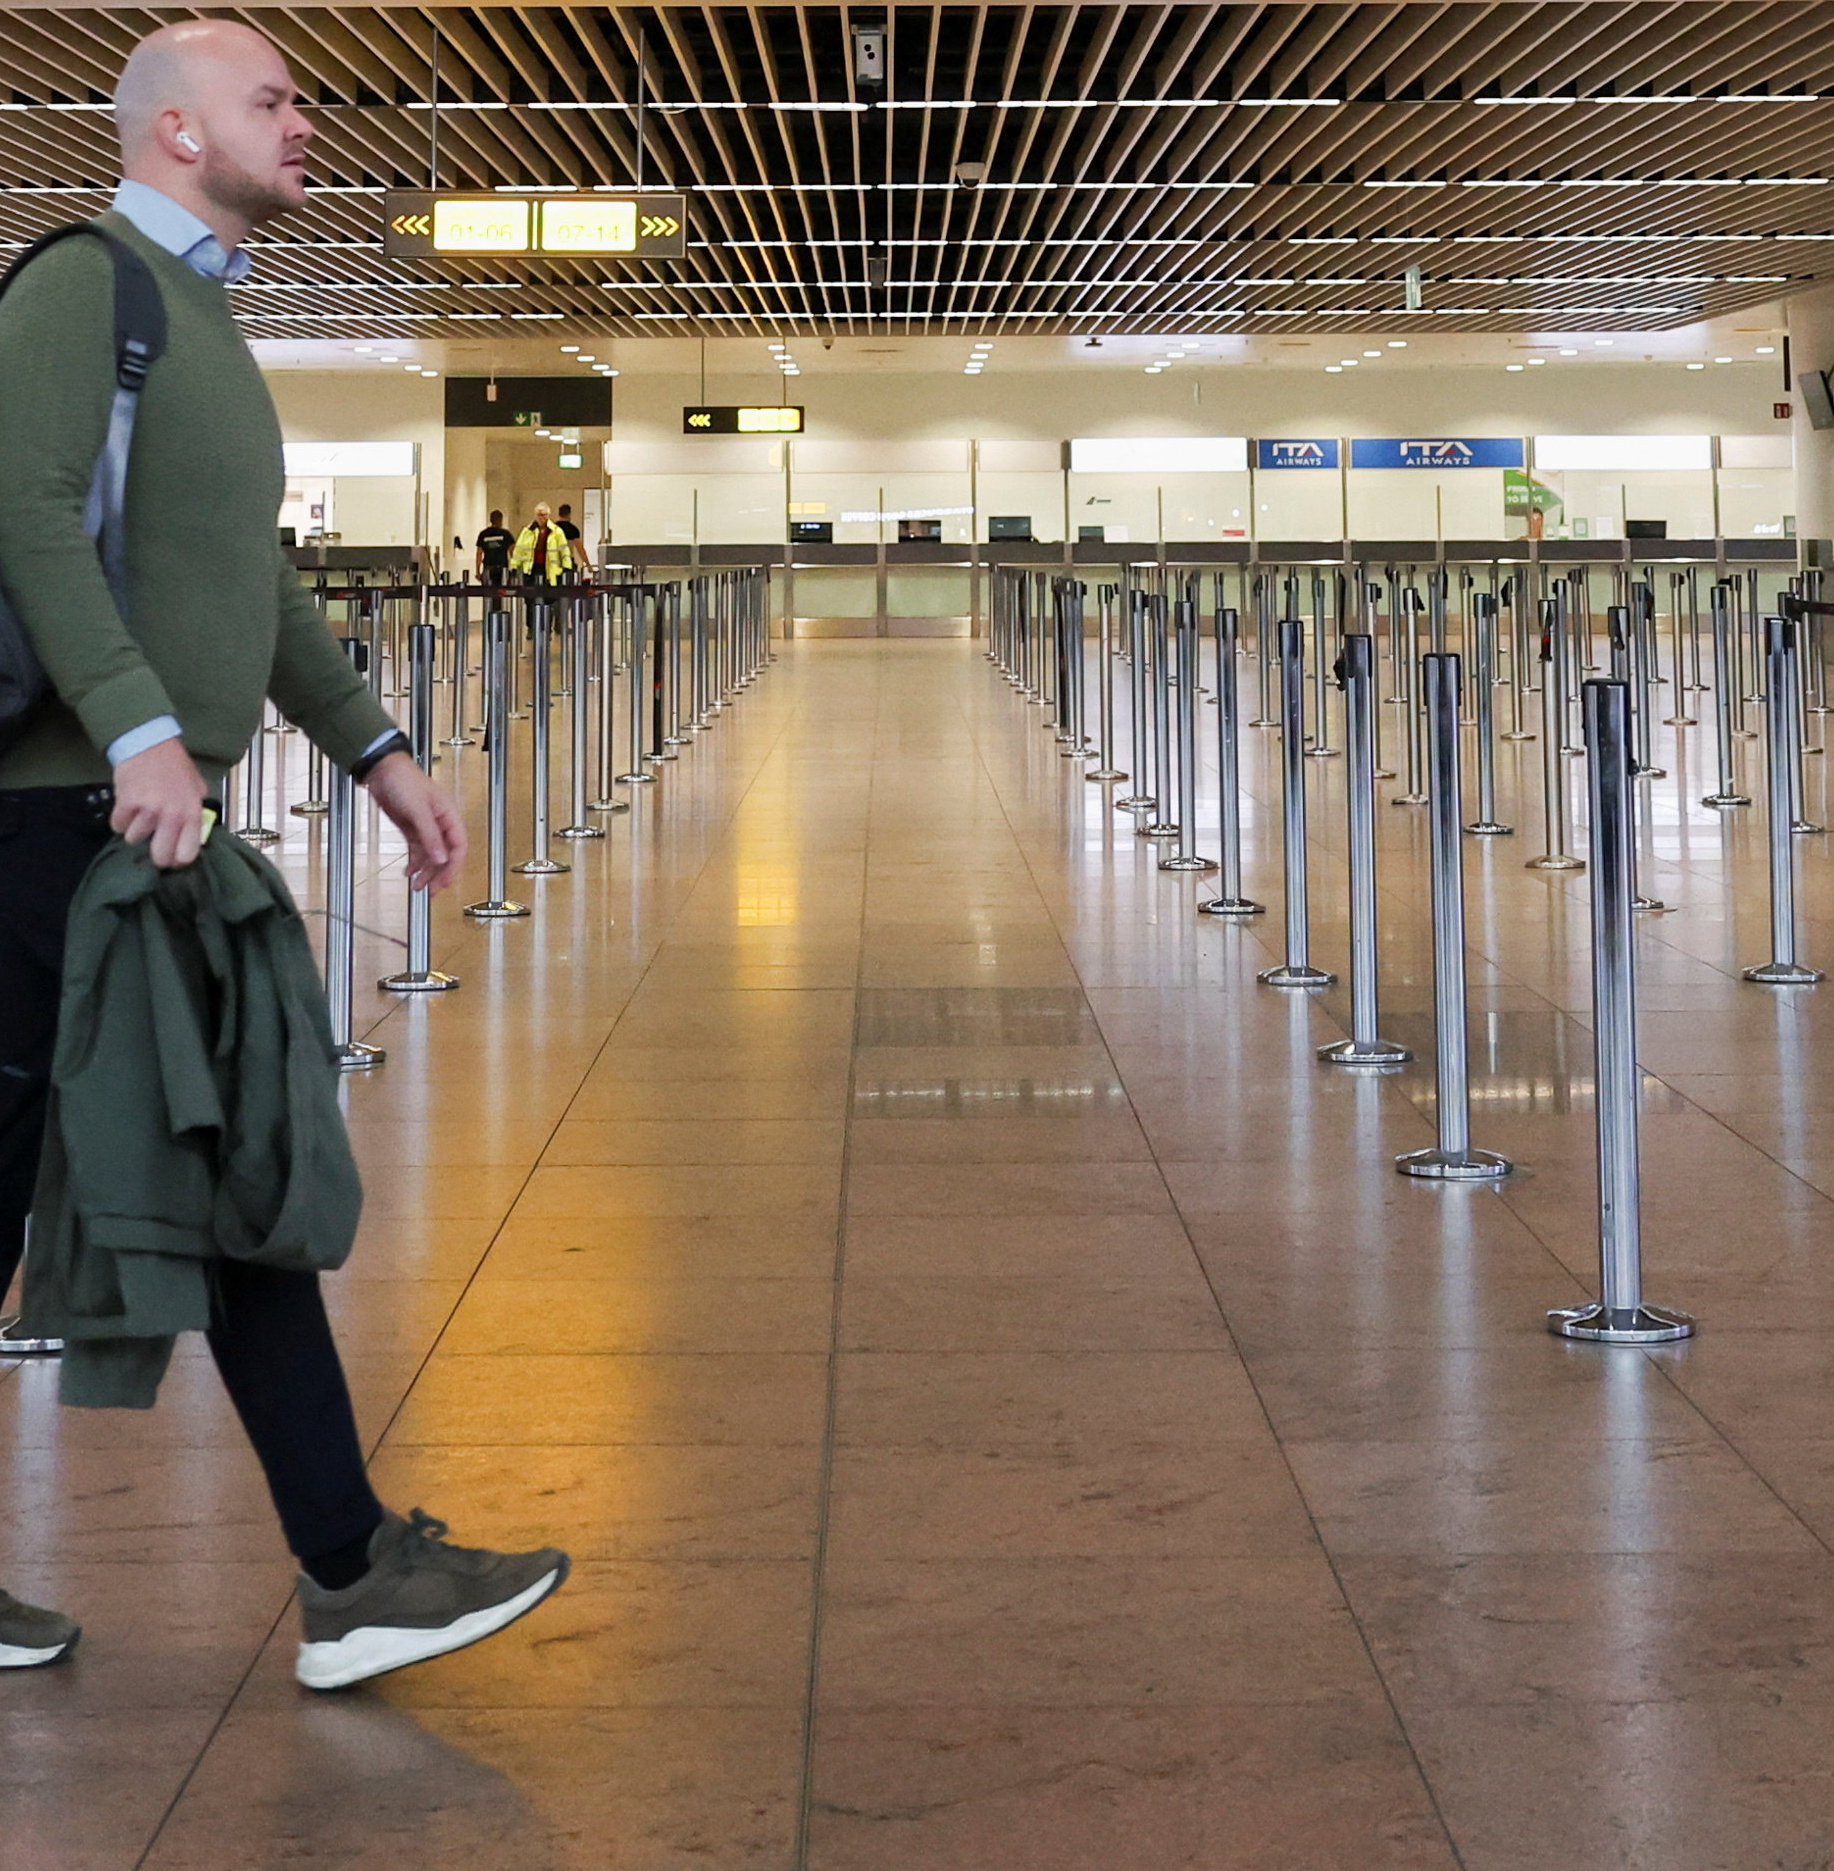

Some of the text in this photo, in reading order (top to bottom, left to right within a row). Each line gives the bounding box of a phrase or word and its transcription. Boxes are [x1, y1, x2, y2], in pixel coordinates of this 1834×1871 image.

[449, 223, 514, 243] 01-06
[556, 224, 621, 243] 07-14
[1271, 442, 1325, 457] ITA
[1399, 441, 1474, 457] ITA
[1275, 457, 1322, 466] AIRWAYS
[1405, 456, 1470, 466] AIRWAYS
